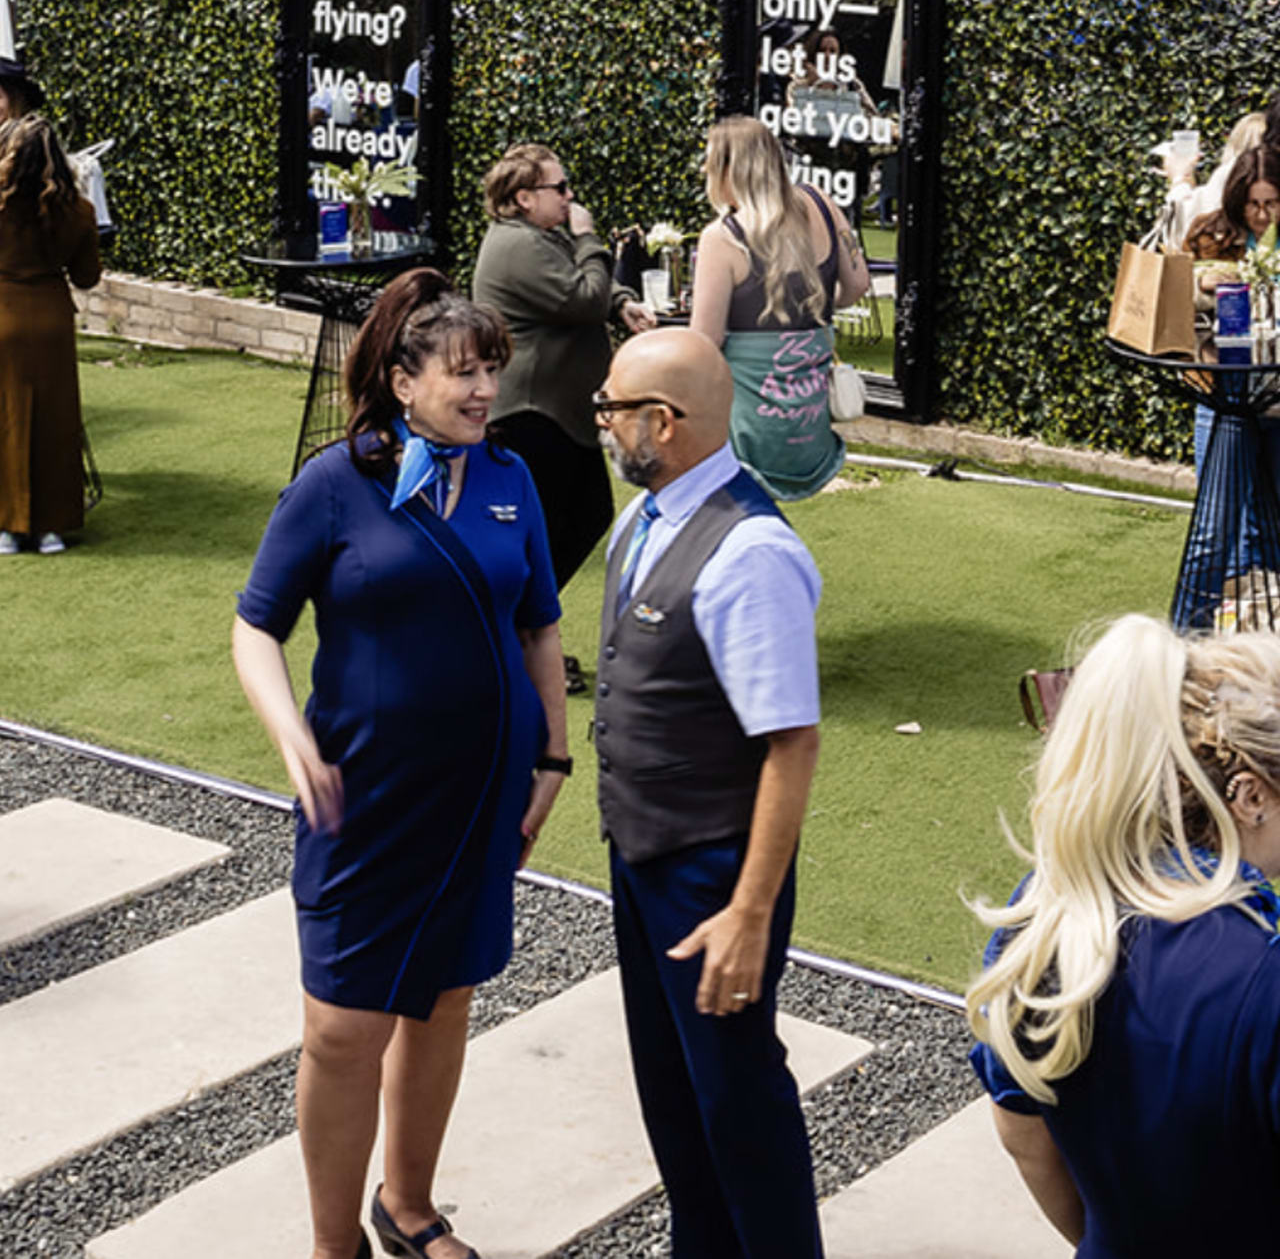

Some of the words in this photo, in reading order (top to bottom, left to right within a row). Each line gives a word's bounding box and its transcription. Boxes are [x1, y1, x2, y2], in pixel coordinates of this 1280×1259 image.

[313, 0, 407, 45] flying?
[760, 36, 806, 77] let
[817, 50, 856, 83] us
[311, 124, 413, 165] already
[759, 102, 817, 137] get
[827, 110, 894, 147] you
